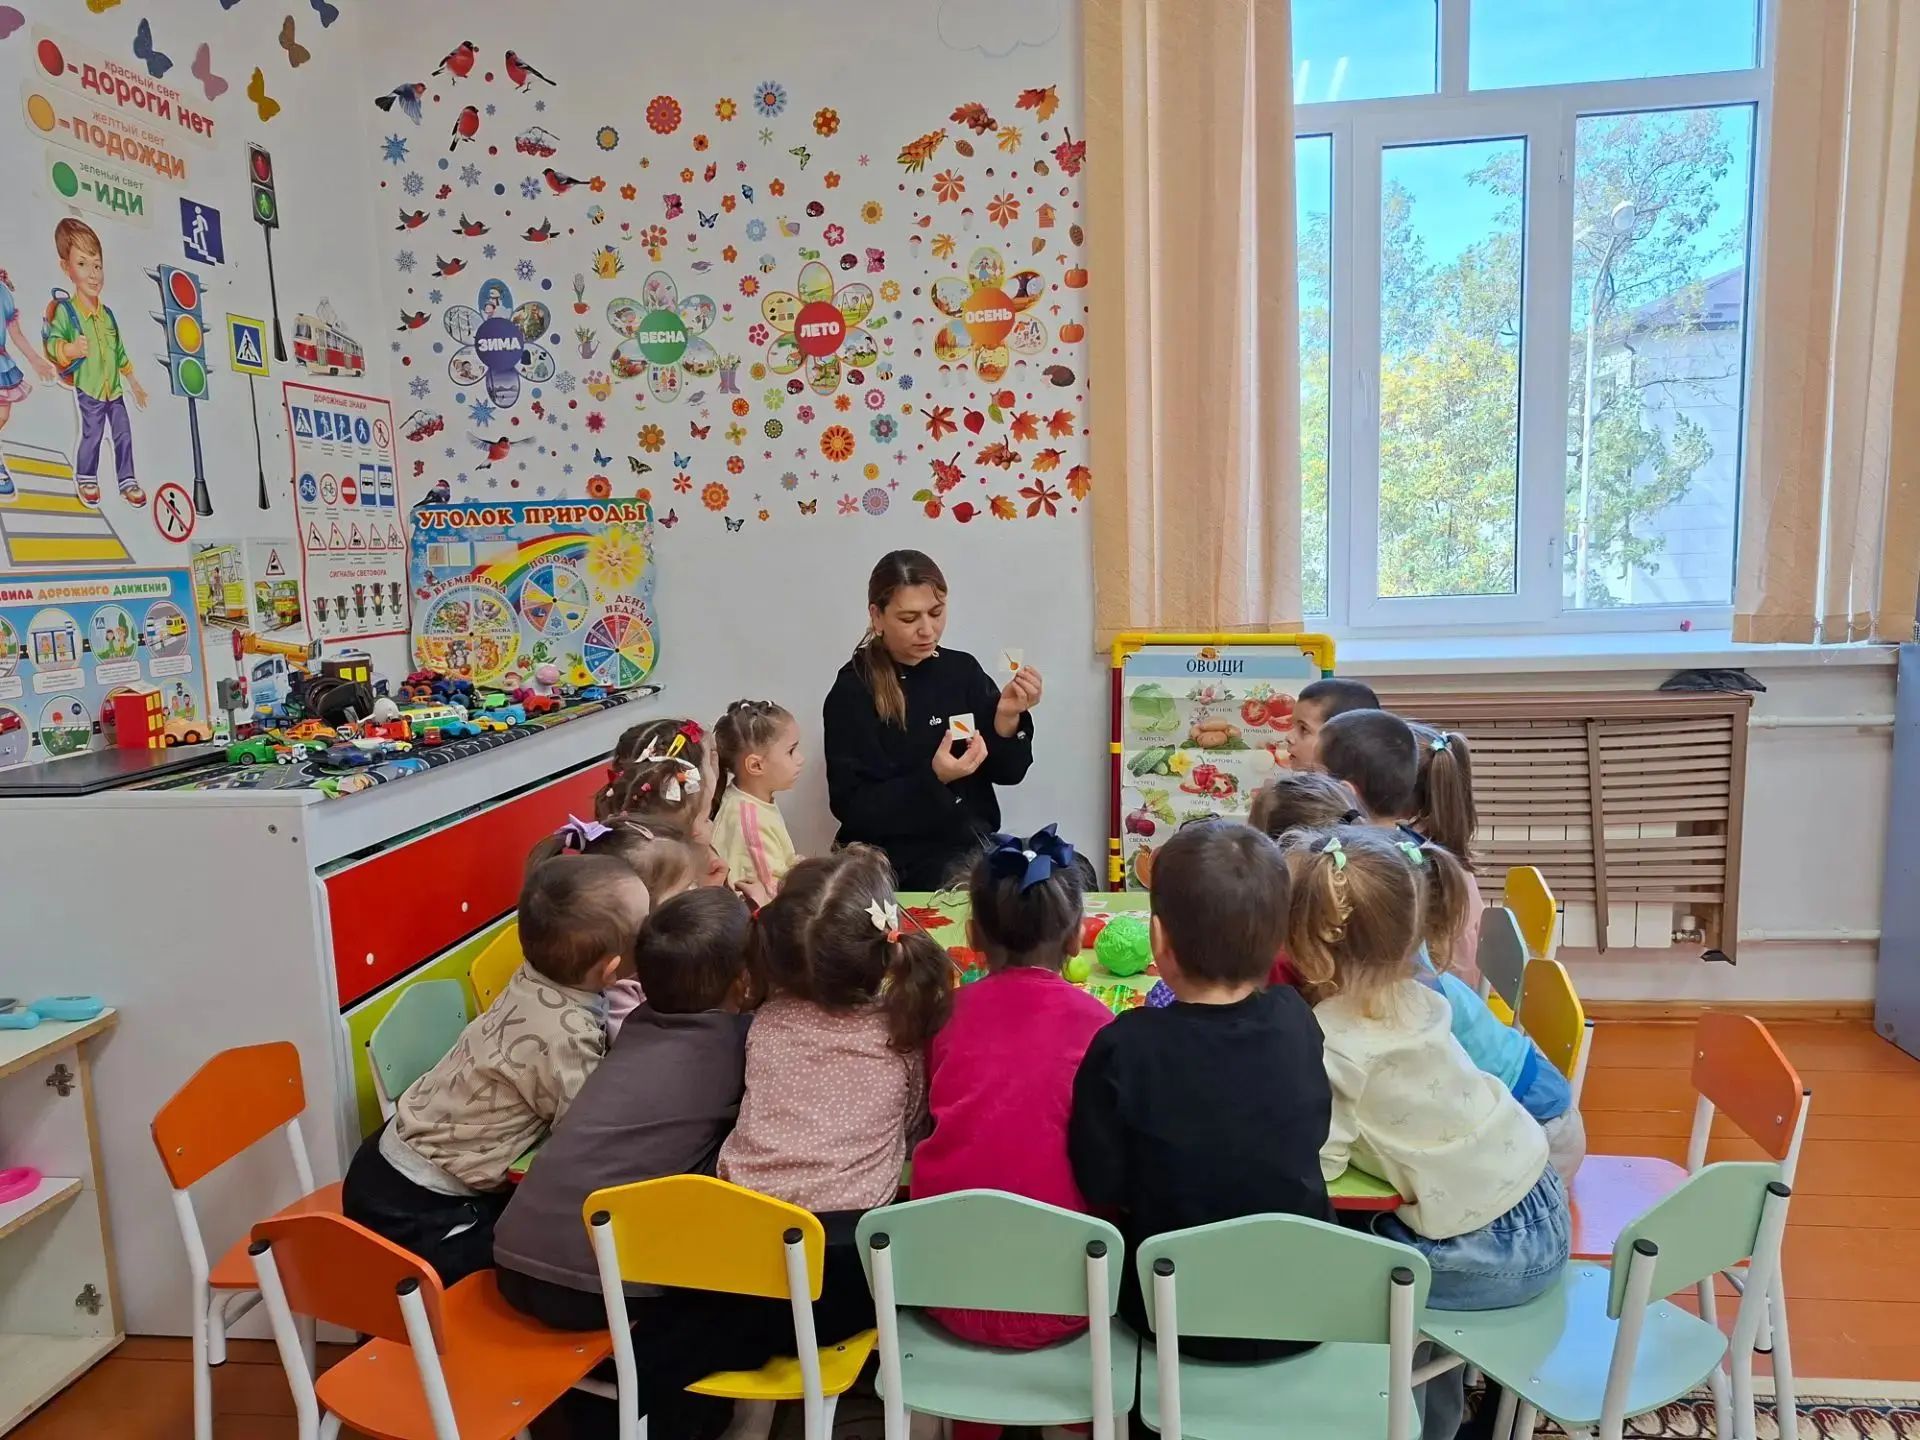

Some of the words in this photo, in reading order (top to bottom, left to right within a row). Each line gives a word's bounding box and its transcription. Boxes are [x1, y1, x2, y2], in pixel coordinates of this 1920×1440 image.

[104, 60, 154, 89] красный
[156, 84, 180, 101] свет
[92, 111, 139, 135] желтый
[141, 130, 165, 147] свет
[80, 162, 120, 182] зеленый
[122, 178, 144, 190] свет
[965, 308, 1013, 324] ОСЕНЬ
[639, 331, 686, 344] ВЕСНА
[800, 321, 840, 337] ЛЕТО
[478, 337, 522, 352] ЗИМА
[313, 394, 347, 407] ДОРОЖНЫЕ
[417, 508, 514, 528] УГОЛОК
[523, 504, 647, 525] ПРИРОДЫ
[528, 554, 578, 570] ПОГОДА
[329, 570, 356, 578] СИГНАЛЫ
[0, 589, 34, 601] ВИЛА
[38, 585, 110, 600] ДОРОЖНОГО
[113, 582, 168, 596] ДВИЖЕНИЯ
[433, 575, 472, 595] ВРЕМЯ
[477, 575, 507, 594] ГОДА
[615, 594, 646, 611] ДЕНЬ
[605, 604, 653, 627] НЕДЕЛИ
[1186, 659, 1244, 676] ОВОЩИ
